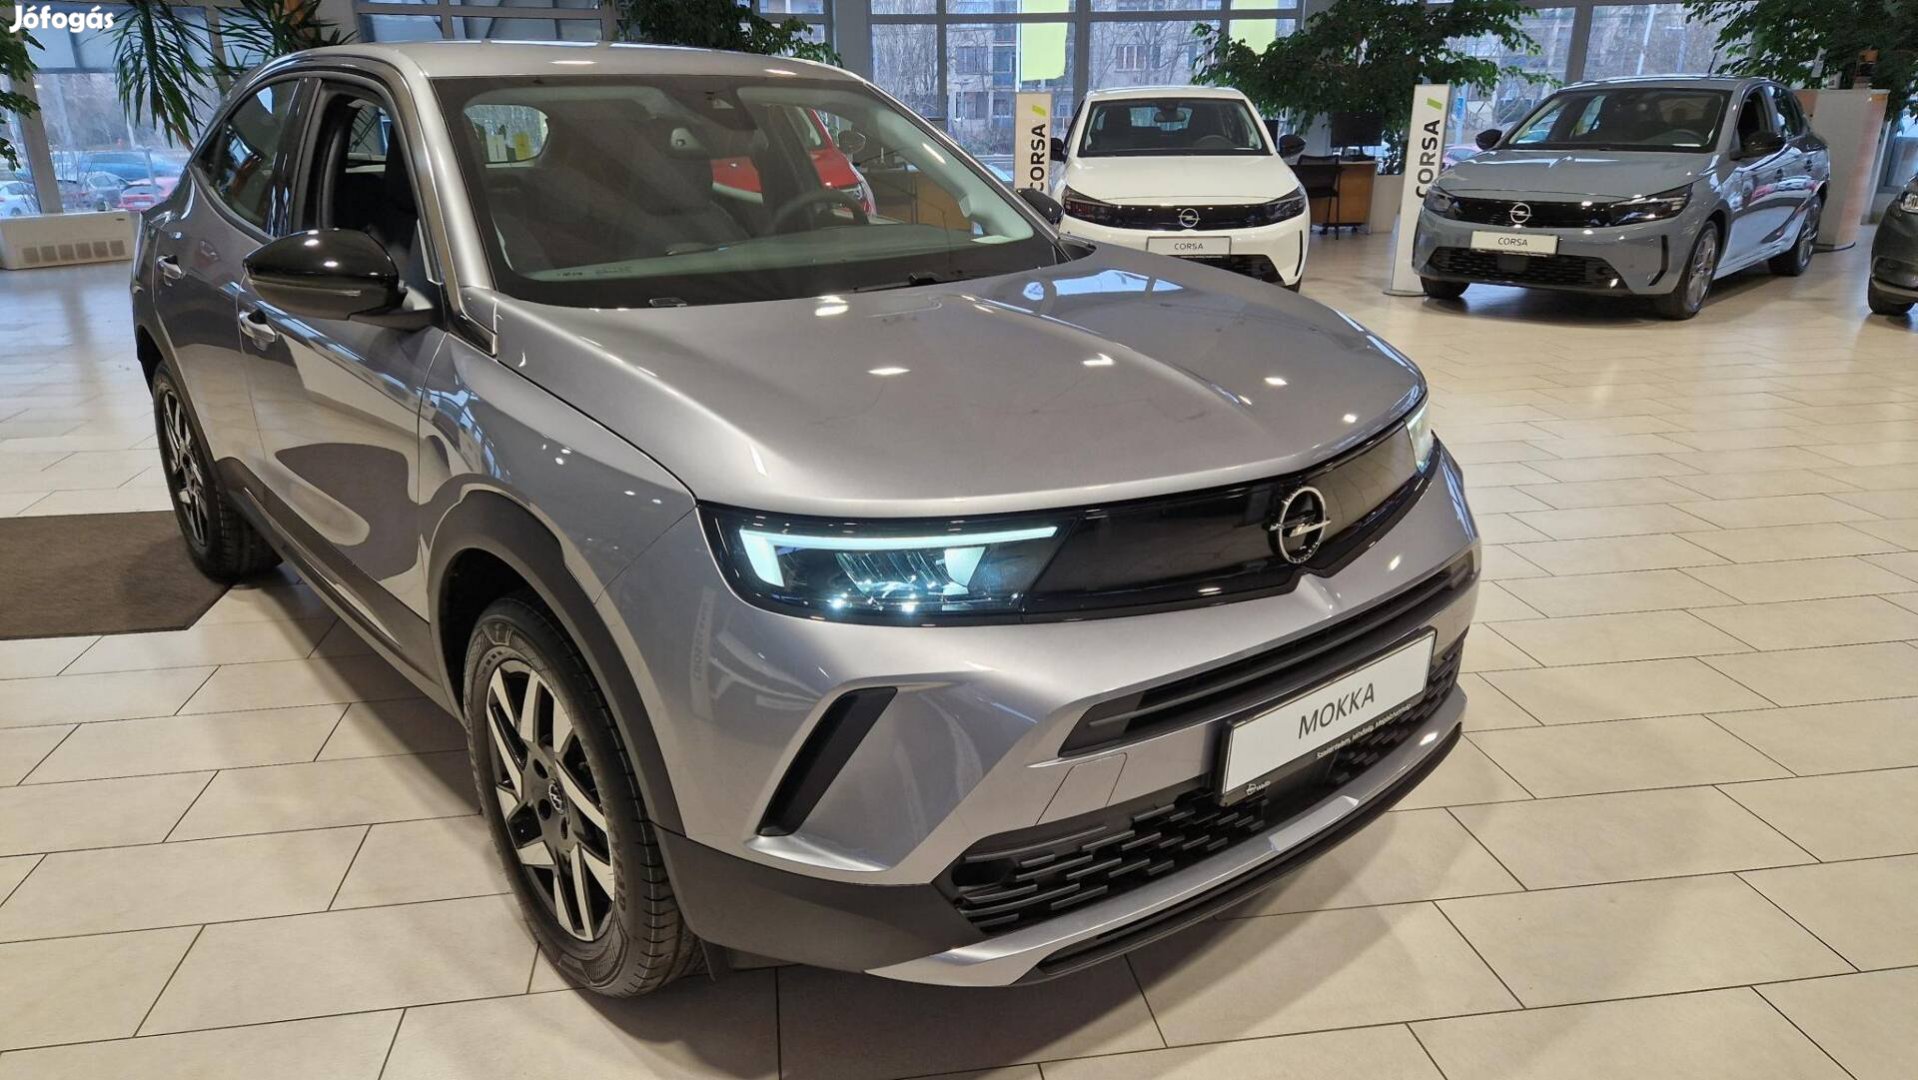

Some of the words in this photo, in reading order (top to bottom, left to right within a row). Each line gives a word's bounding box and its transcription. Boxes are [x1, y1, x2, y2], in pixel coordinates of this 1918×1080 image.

[1416, 120, 1440, 198] CORSA
[1174, 243, 1204, 251] CORSA
[1497, 237, 1528, 247] CORSA
[1298, 682, 1375, 739] MOKKA
